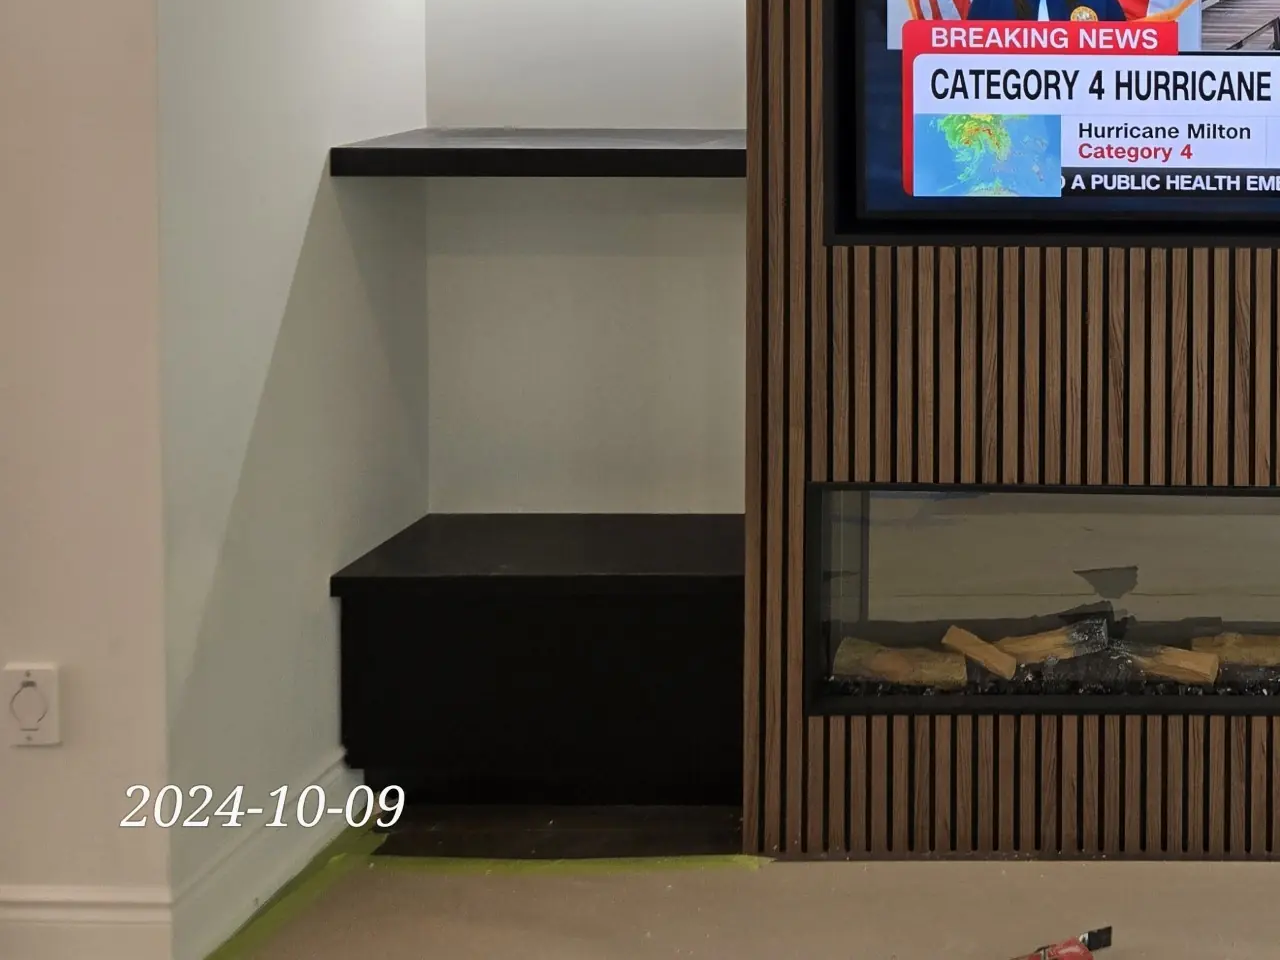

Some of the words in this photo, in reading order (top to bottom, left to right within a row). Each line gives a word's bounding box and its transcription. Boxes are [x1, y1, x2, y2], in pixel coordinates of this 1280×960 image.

[931, 27, 1069, 49] BREAKING
[1077, 28, 1158, 50] NEWS
[930, 68, 1080, 100] CATEGORY
[1088, 70, 1105, 100] 4
[1115, 70, 1272, 102] HURRICANE
[1078, 122, 1180, 139] Hurricane
[1187, 122, 1251, 139] Milton
[1078, 143, 1173, 163] Category
[1180, 144, 1193, 160] 4
[1071, 174, 1086, 190] A
[1090, 174, 1160, 190] PUBLIC
[1166, 174, 1240, 191] HEALTH
